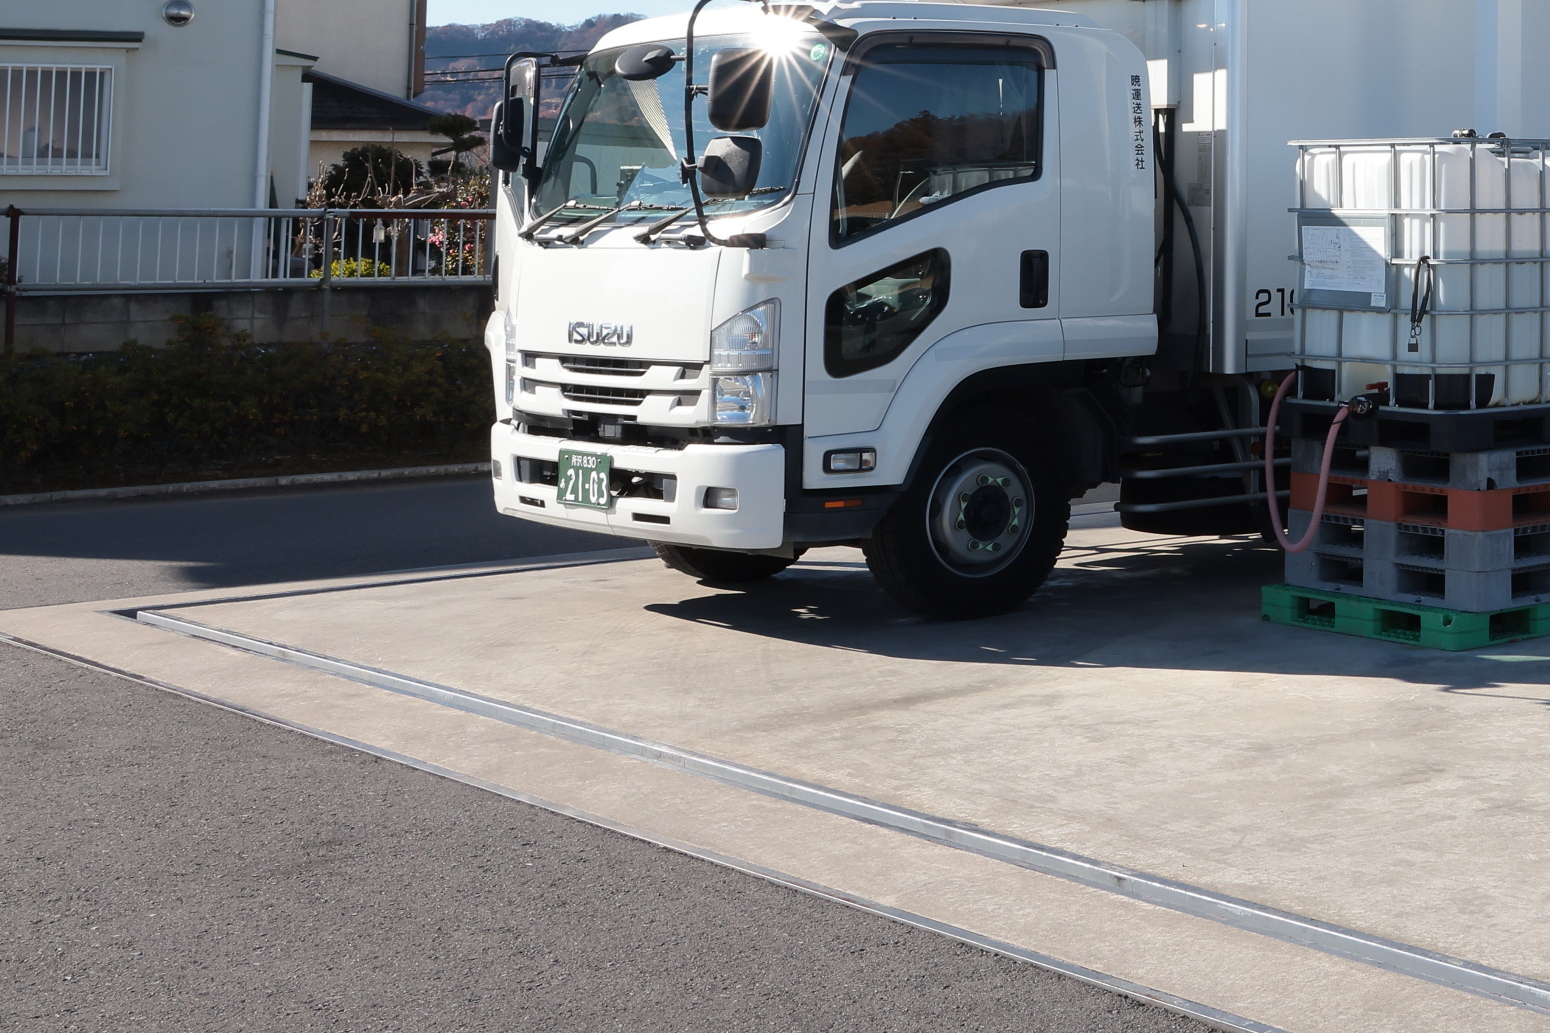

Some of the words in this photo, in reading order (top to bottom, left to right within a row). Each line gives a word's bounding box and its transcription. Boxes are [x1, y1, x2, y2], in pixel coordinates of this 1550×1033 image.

[1131, 75, 1146, 170] 暁運送株式会社
[1255, 288, 1295, 317] 21
[568, 321, 633, 347] ISUZU
[583, 456, 597, 469] 830
[565, 468, 607, 505] 21-03
